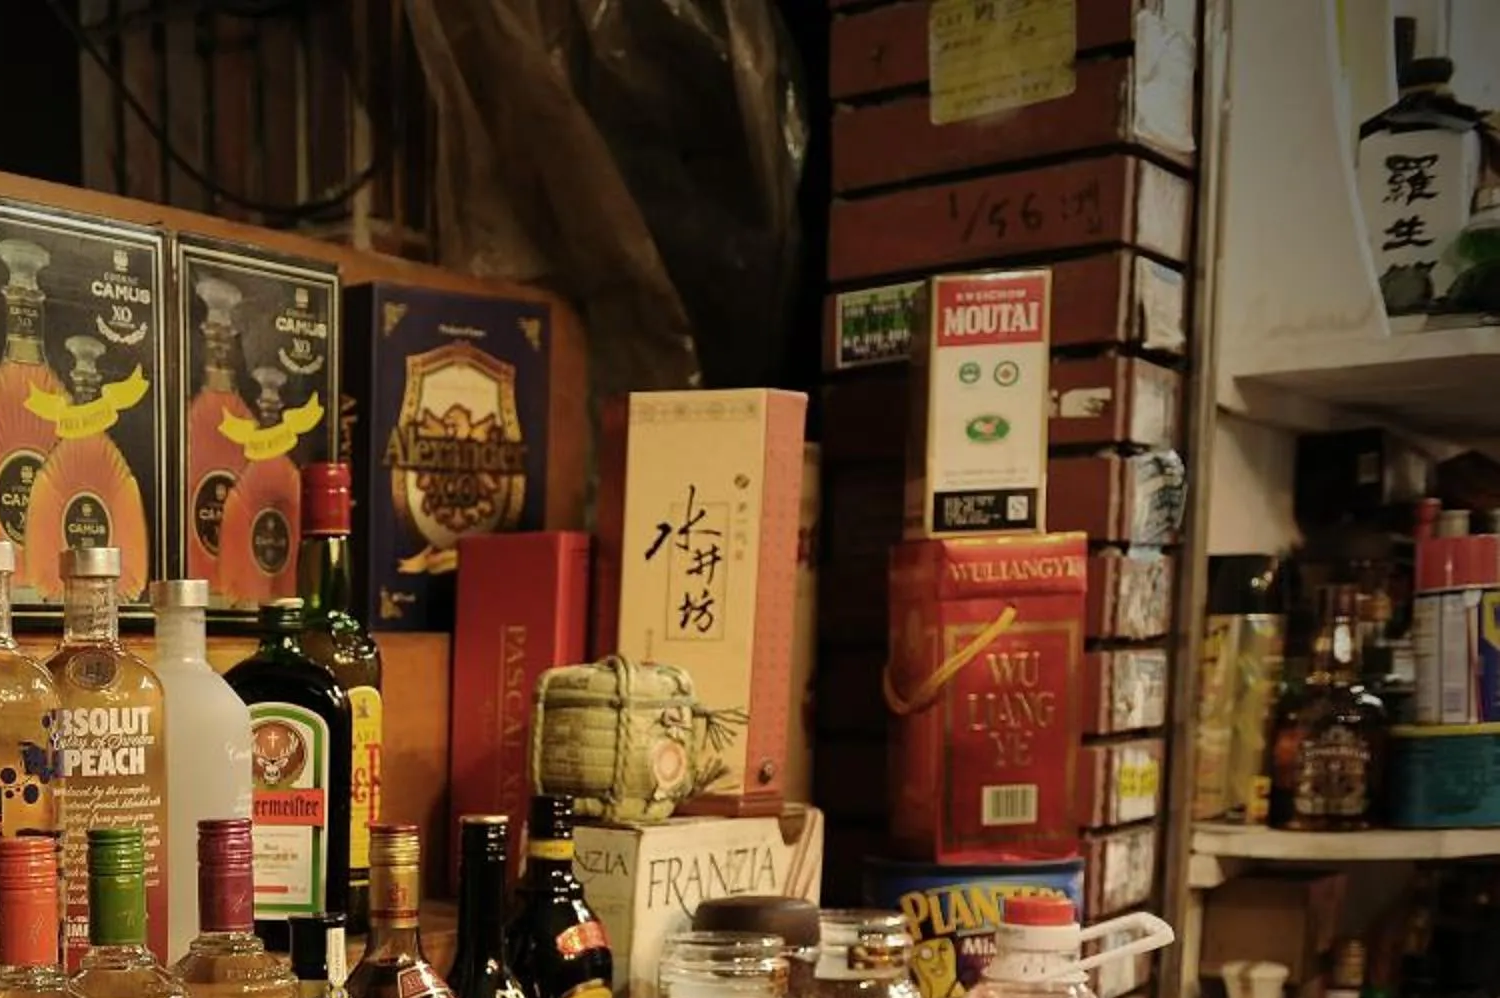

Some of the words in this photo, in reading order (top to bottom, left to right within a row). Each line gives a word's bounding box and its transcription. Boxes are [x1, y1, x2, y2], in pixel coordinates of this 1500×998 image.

[90, 280, 152, 305] CAMUS
[110, 304, 133, 322] XO
[275, 315, 328, 339] CAMUS
[943, 300, 1041, 337] MOUTAI
[382, 422, 526, 474] Alexander
[644, 484, 722, 633] 水井坊
[986, 650, 1040, 688] WU
[967, 691, 1056, 734] LIANG
[63, 747, 146, 777] PEACH
[989, 730, 1033, 768] YE
[647, 847, 777, 921] FRANZIA
